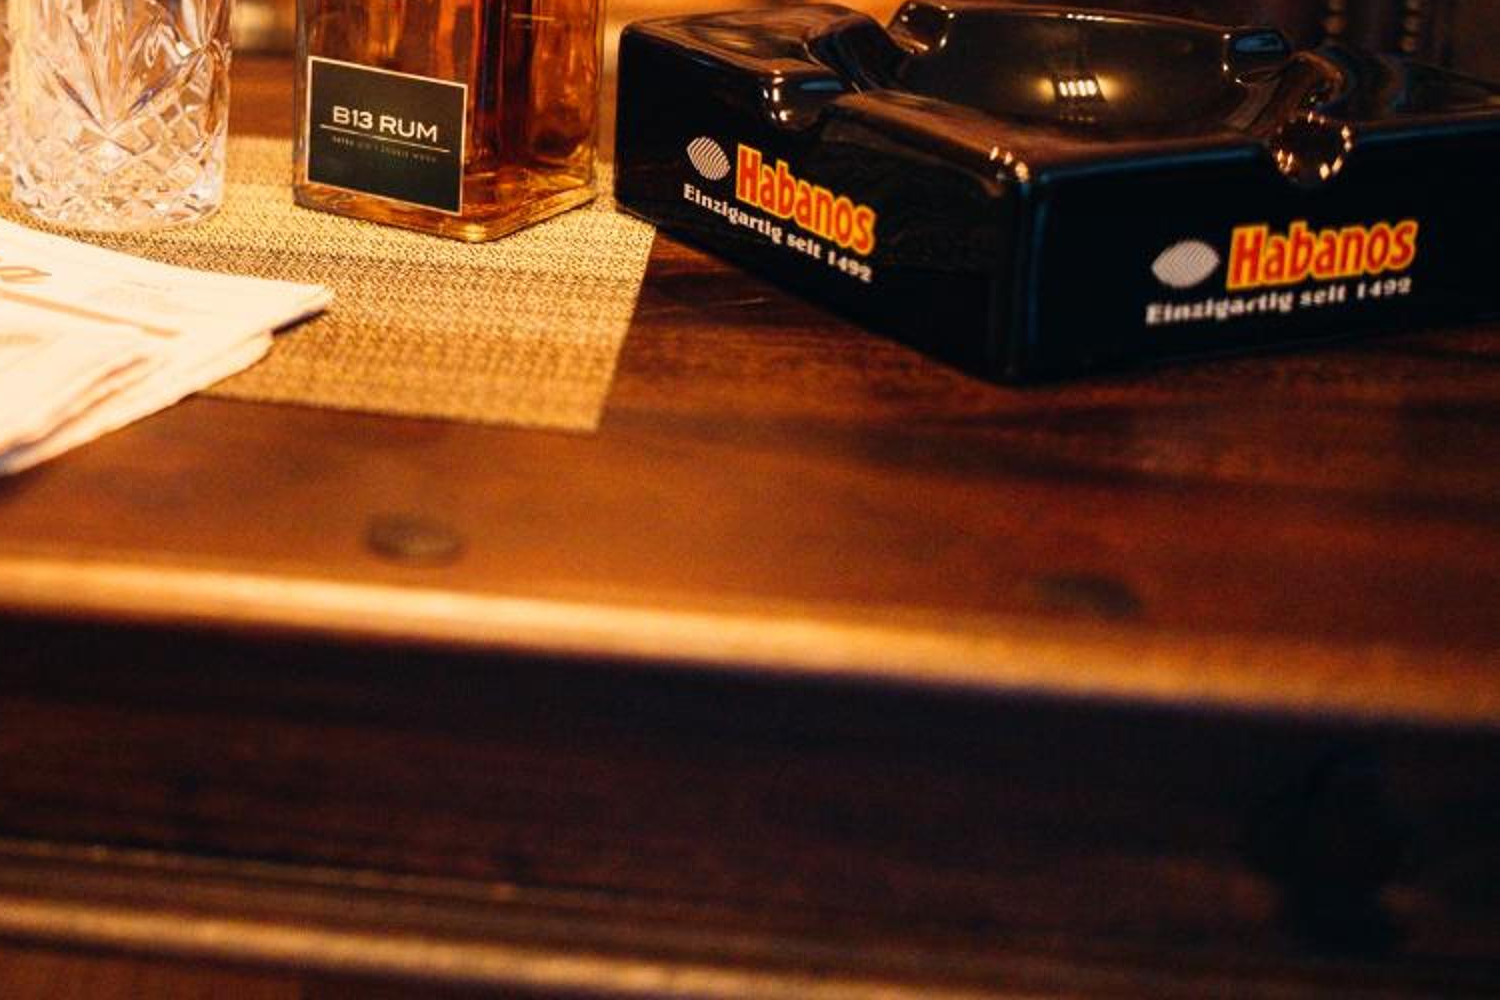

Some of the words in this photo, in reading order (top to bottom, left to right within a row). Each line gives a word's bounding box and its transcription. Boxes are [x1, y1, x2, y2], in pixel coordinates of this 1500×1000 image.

[332, 105, 373, 129] B13
[379, 115, 438, 142] RUM
[683, 183, 783, 244] Einzigartig
[786, 233, 821, 259] seit
[827, 251, 872, 283] 1492
[736, 143, 876, 255] Habanos
[1226, 219, 1418, 289] Habanos
[1145, 292, 1294, 325] Einzigartig
[1298, 285, 1347, 307] seit
[1356, 276, 1412, 299] 1492
